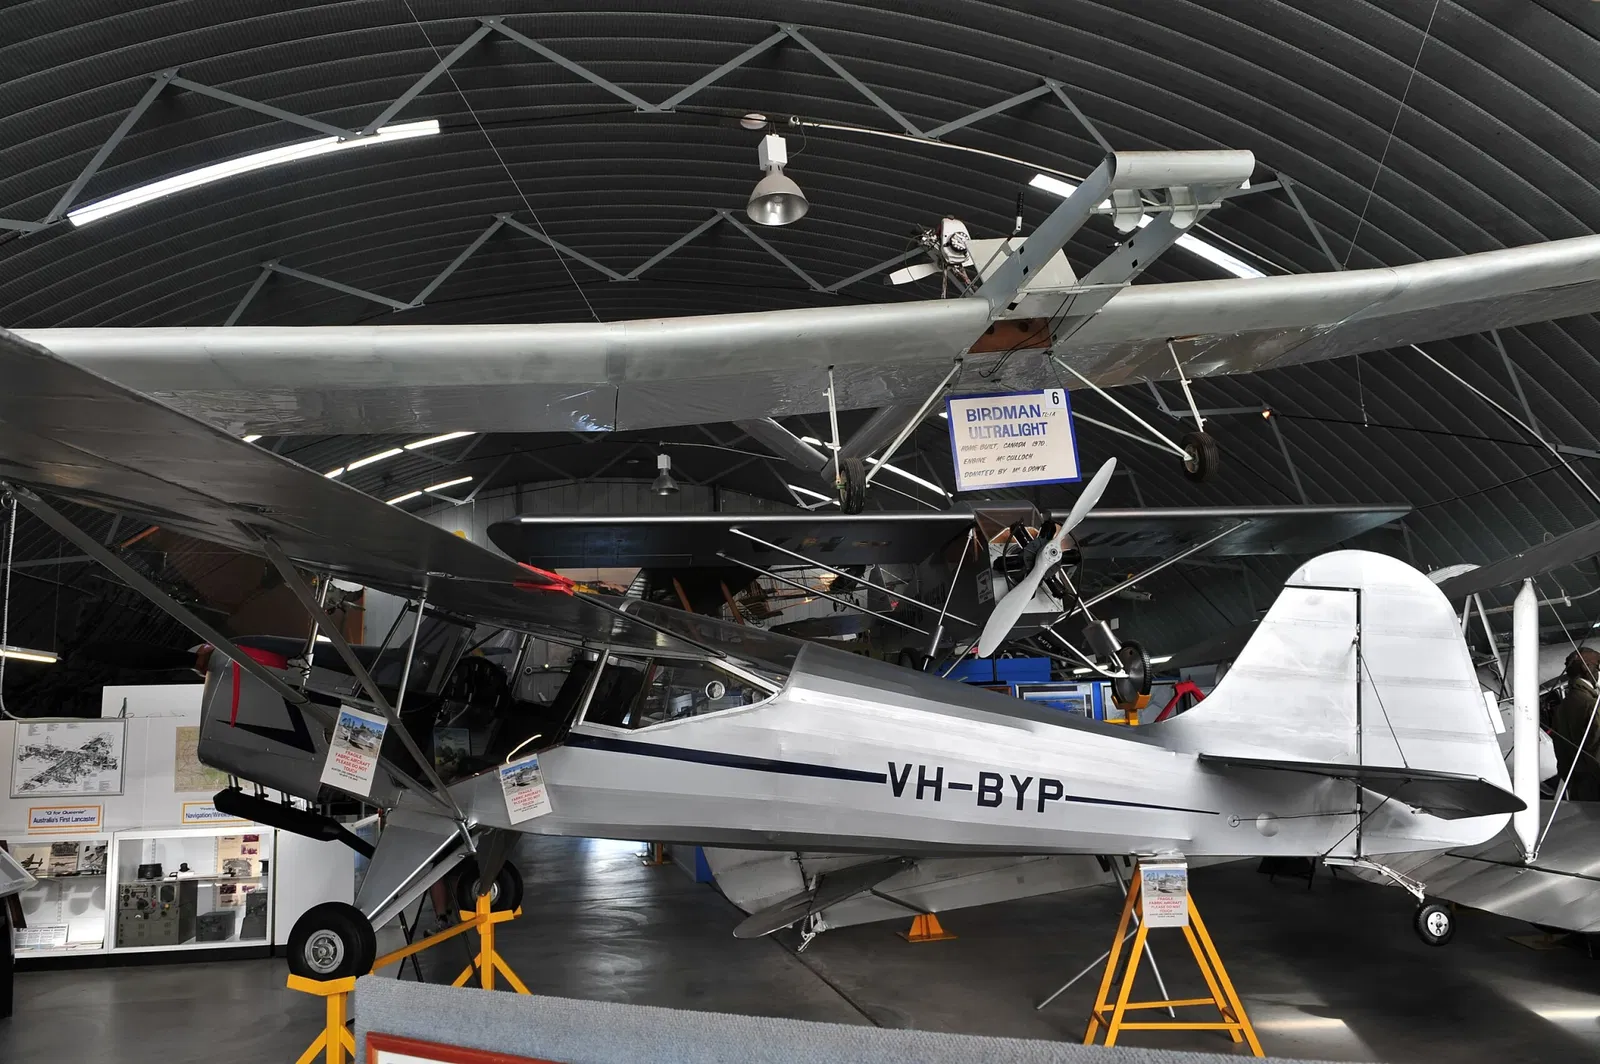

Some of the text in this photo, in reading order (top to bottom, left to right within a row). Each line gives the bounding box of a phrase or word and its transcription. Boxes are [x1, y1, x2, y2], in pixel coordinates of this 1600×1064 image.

[1052, 391, 1060, 404] 6
[966, 404, 1041, 422] BIRDMAN
[968, 422, 1048, 440] ULTRALIGHT
[963, 456, 987, 464] ENGINE
[964, 469, 995, 478] DONATED
[888, 762, 1064, 813] VH-BYP
